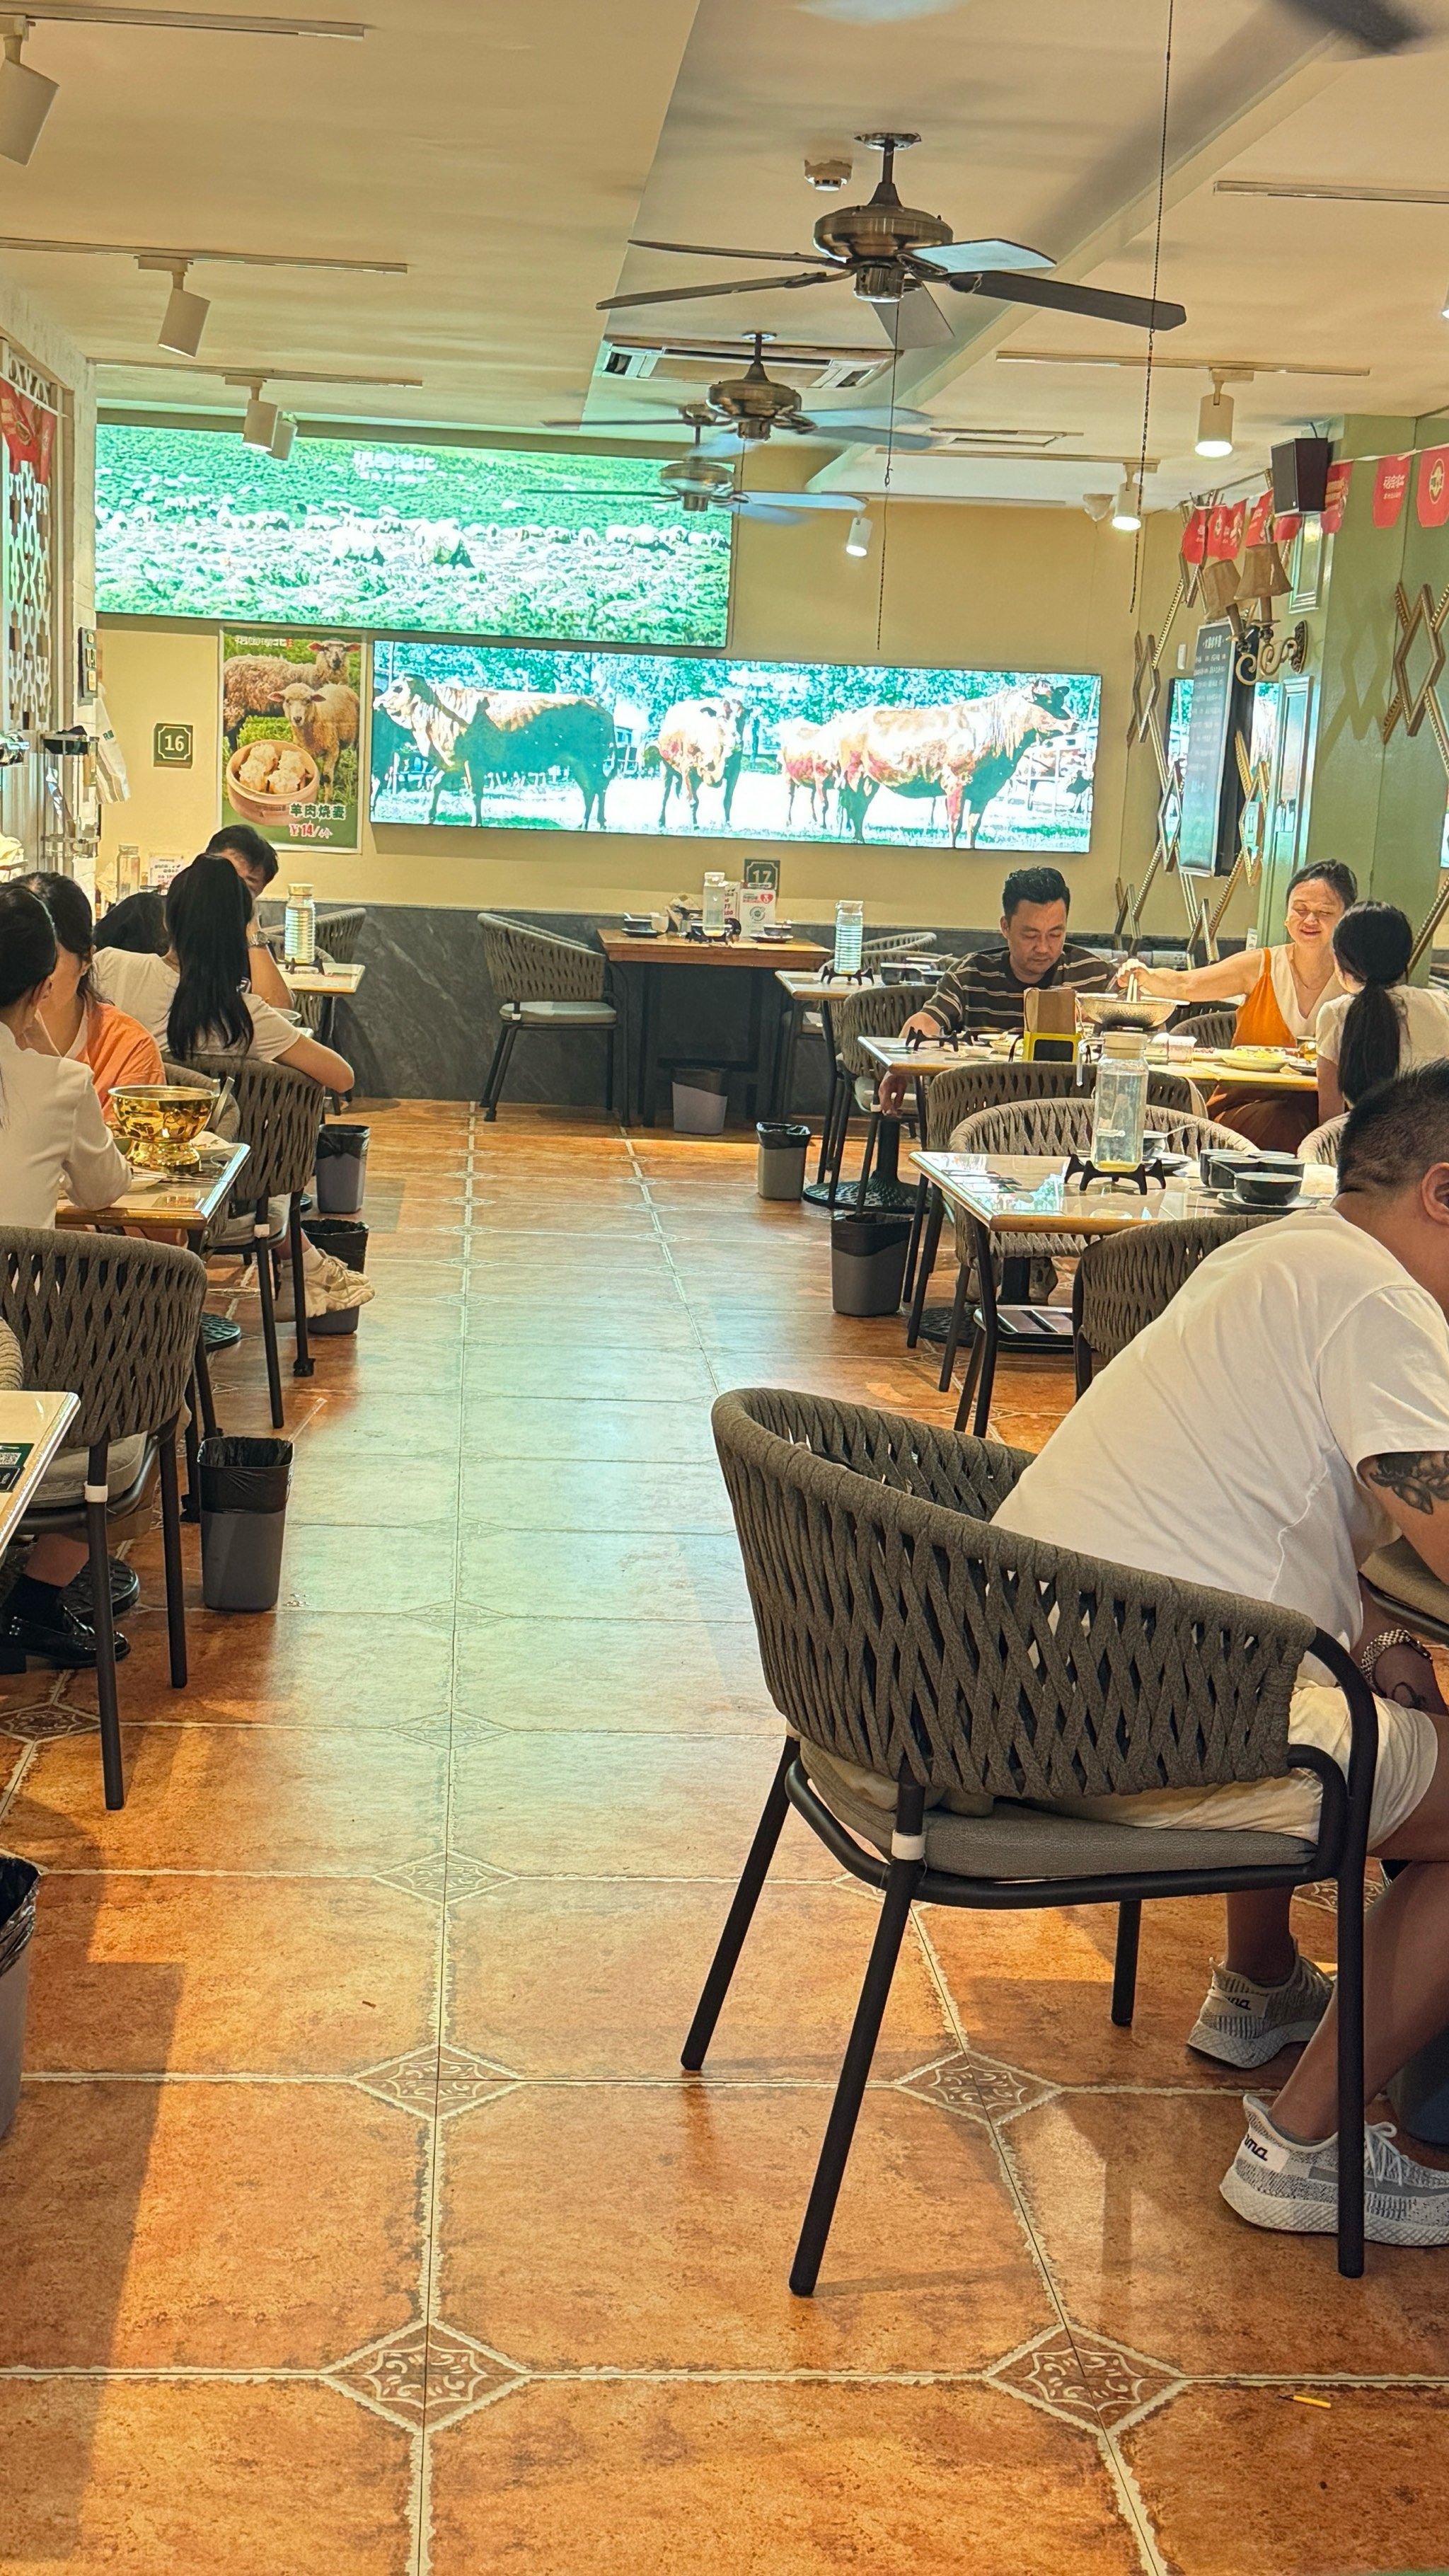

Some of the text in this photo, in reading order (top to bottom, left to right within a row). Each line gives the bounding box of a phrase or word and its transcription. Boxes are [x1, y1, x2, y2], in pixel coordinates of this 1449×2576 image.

[165, 735, 185, 752] 16
[290, 803, 345, 819] 羊肉烧麦
[754, 869, 771, 884] 17
